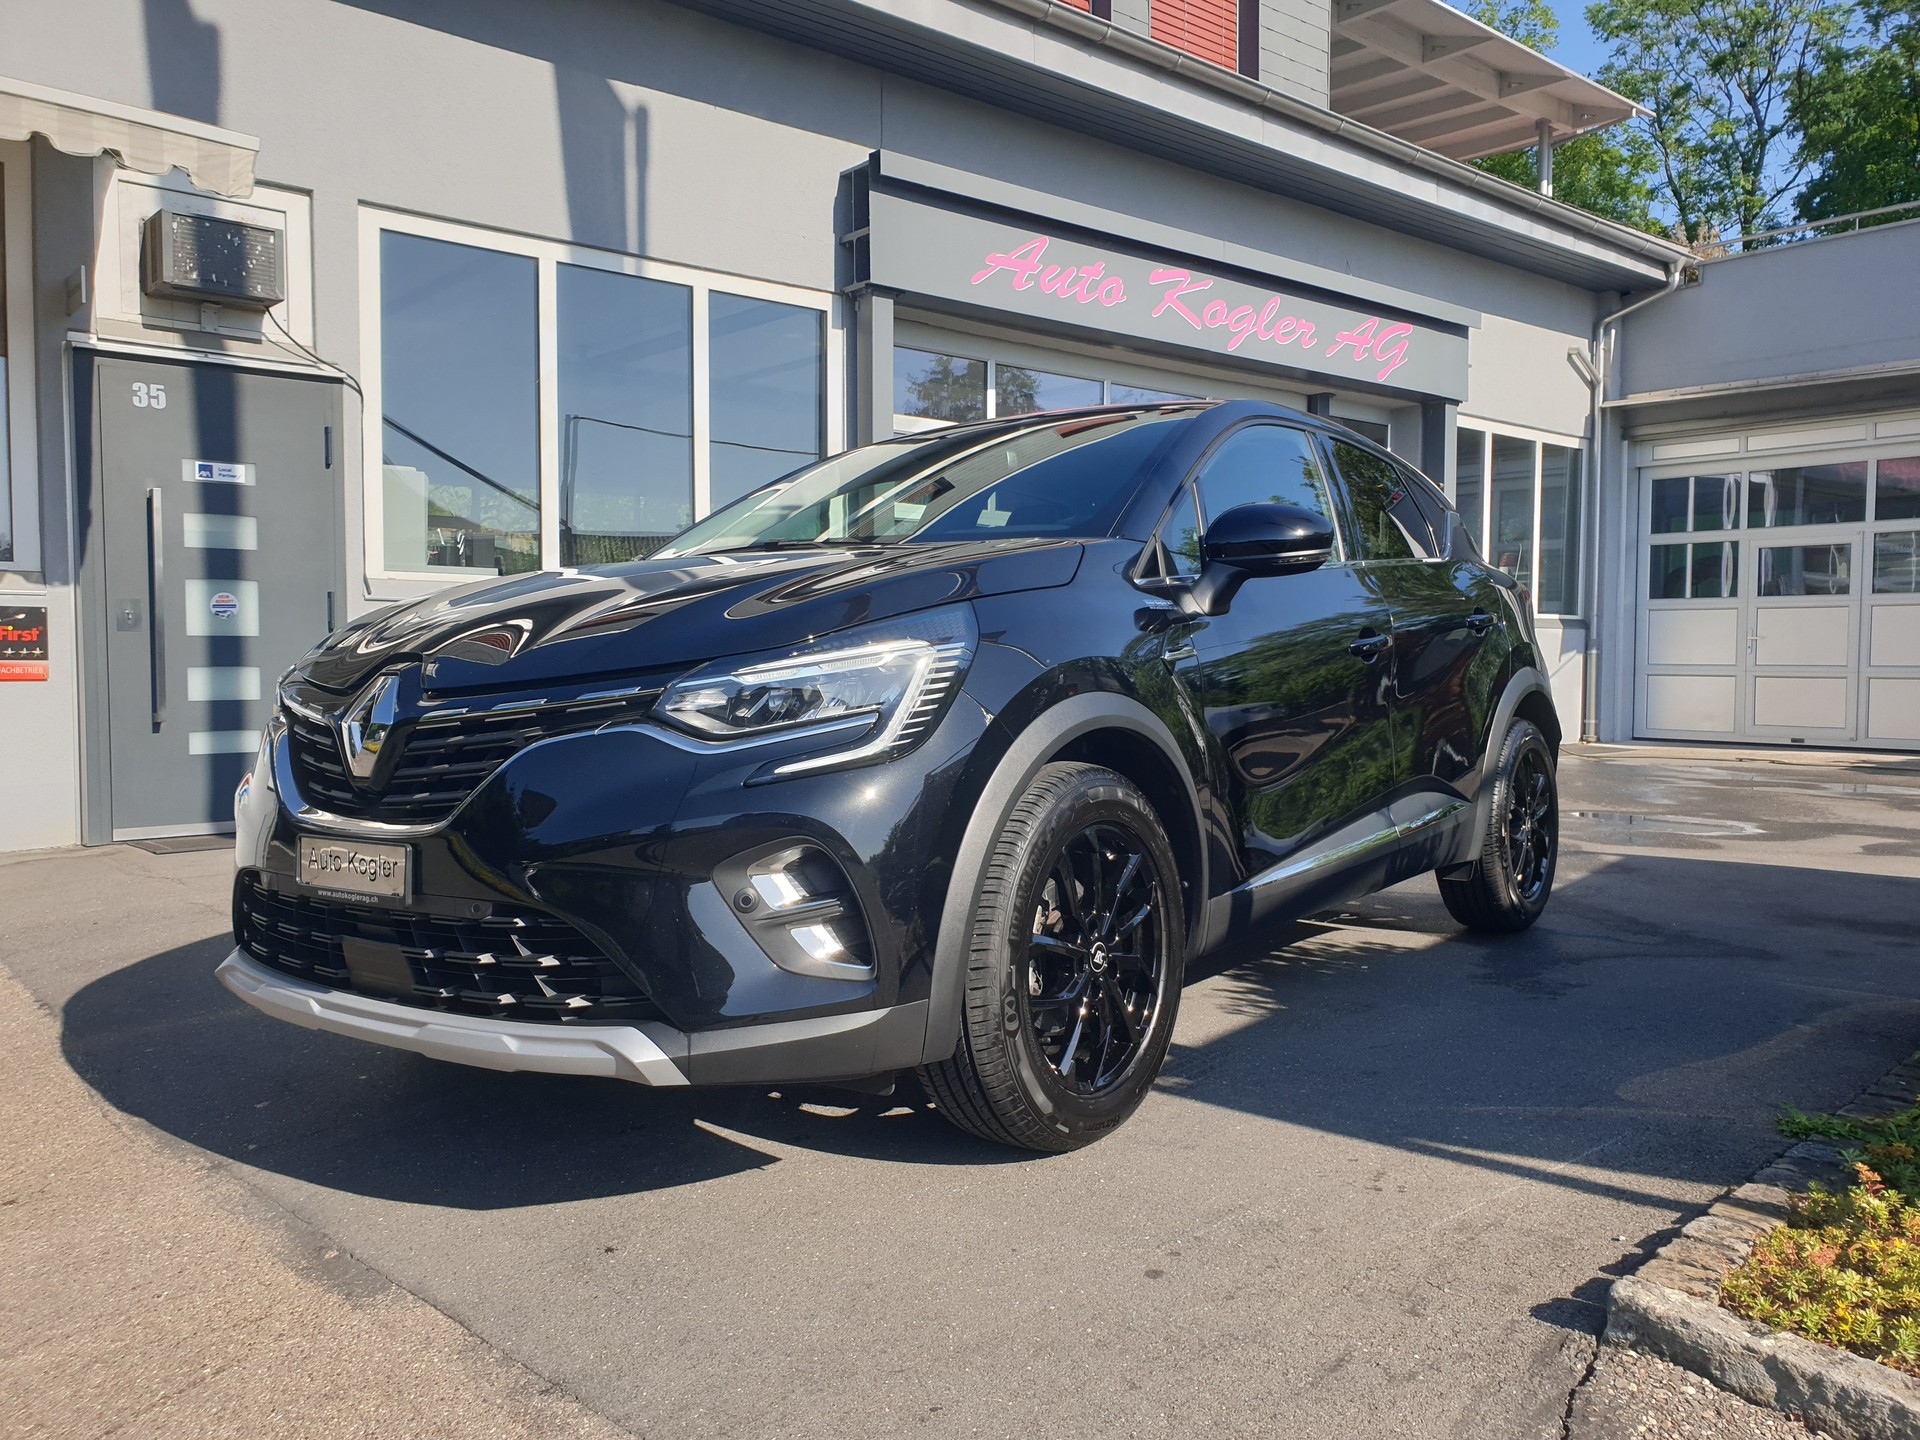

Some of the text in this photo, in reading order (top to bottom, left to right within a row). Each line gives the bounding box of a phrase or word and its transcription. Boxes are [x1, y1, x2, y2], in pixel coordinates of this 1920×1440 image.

[970, 235, 1414, 382] Auto Kogler AG
[132, 381, 167, 410] 35
[308, 847, 398, 882] Auto Kogler
[317, 889, 379, 904] www.autokoglerag.ch
